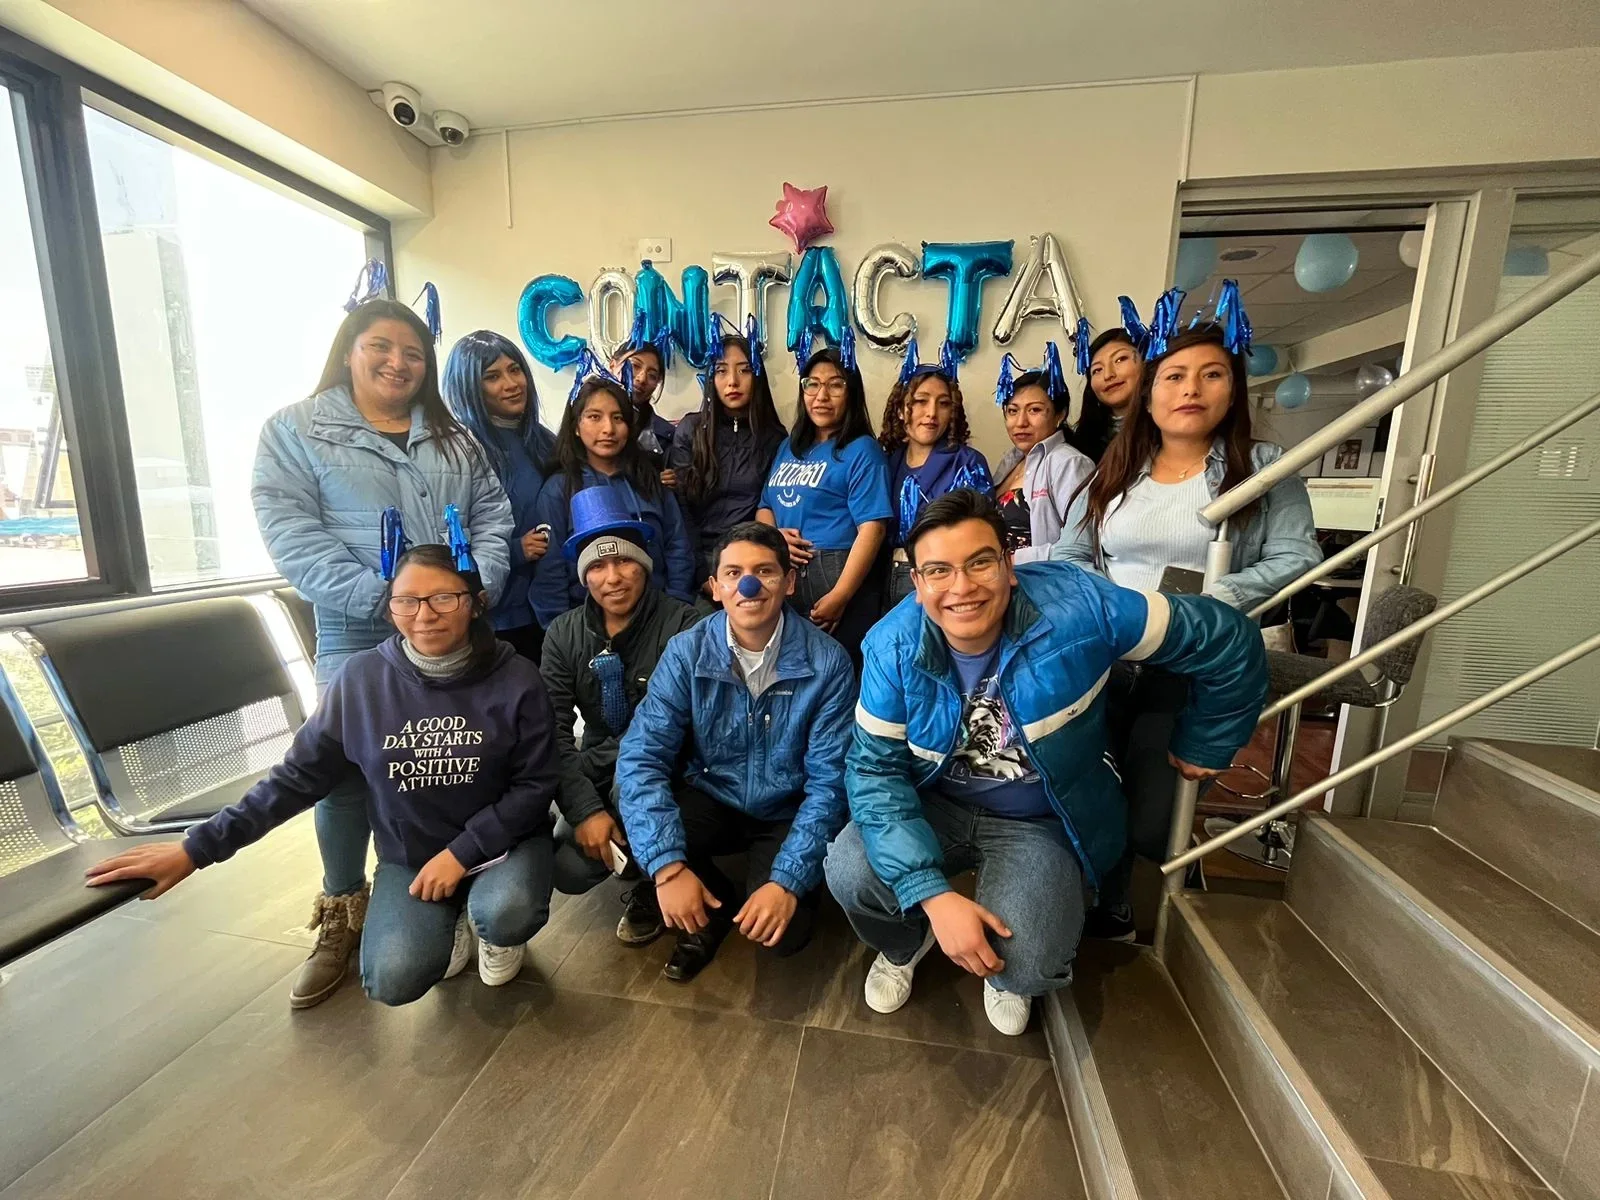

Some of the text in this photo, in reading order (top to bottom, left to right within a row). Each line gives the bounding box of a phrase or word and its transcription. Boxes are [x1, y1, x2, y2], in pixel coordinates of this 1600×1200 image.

[517, 232, 1087, 372] CONTACTA
[768, 461, 828, 488] CHICAGO
[400, 716, 466, 734] A GOOD
[382, 731, 483, 750] DAY STARTS
[414, 747, 452, 758] WITH A
[388, 757, 481, 779] POSITIVE
[397, 774, 474, 793] ATTITUDE
